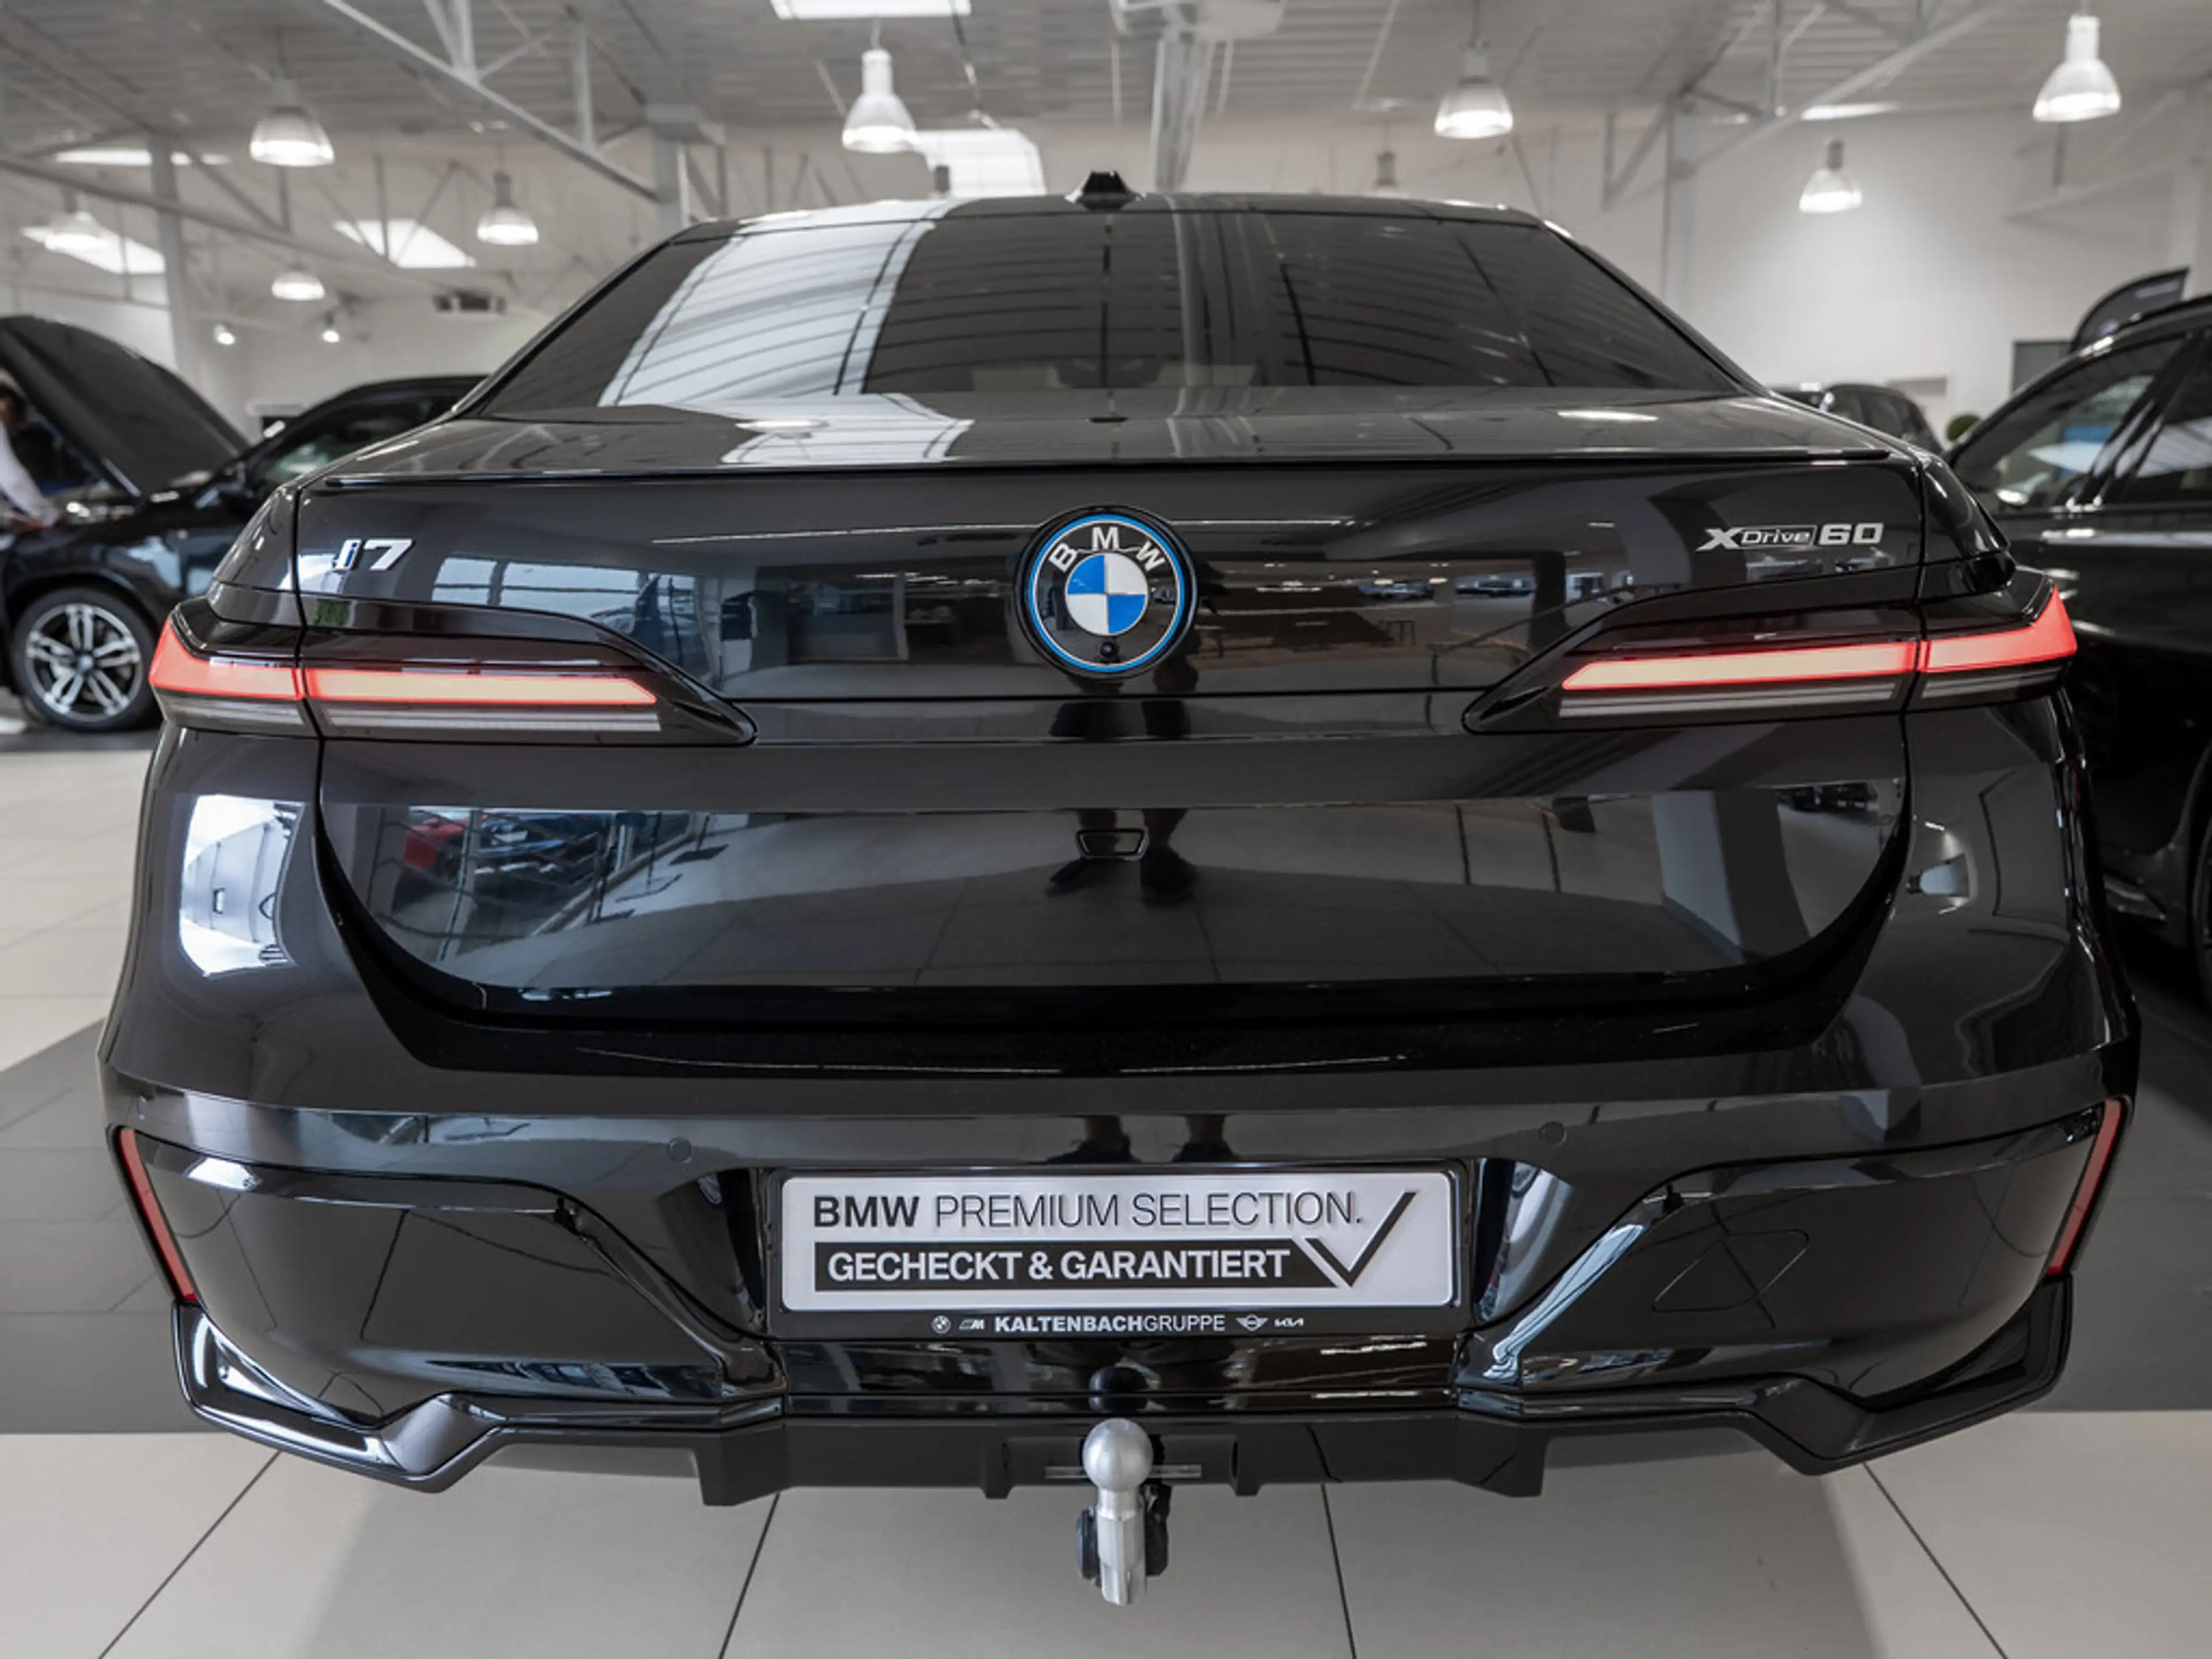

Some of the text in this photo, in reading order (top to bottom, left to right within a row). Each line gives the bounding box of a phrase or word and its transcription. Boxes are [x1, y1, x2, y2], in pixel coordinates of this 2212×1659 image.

[334, 539, 413, 570] i7
[1048, 527, 1165, 573] BMW
[813, 1191, 1362, 1228] BMW PREMIUM SELECTION.
[828, 1249, 1291, 1282] GECHECKT & GARANTIERT
[995, 1315, 1225, 1333] KALTENBACHGRUPPE
